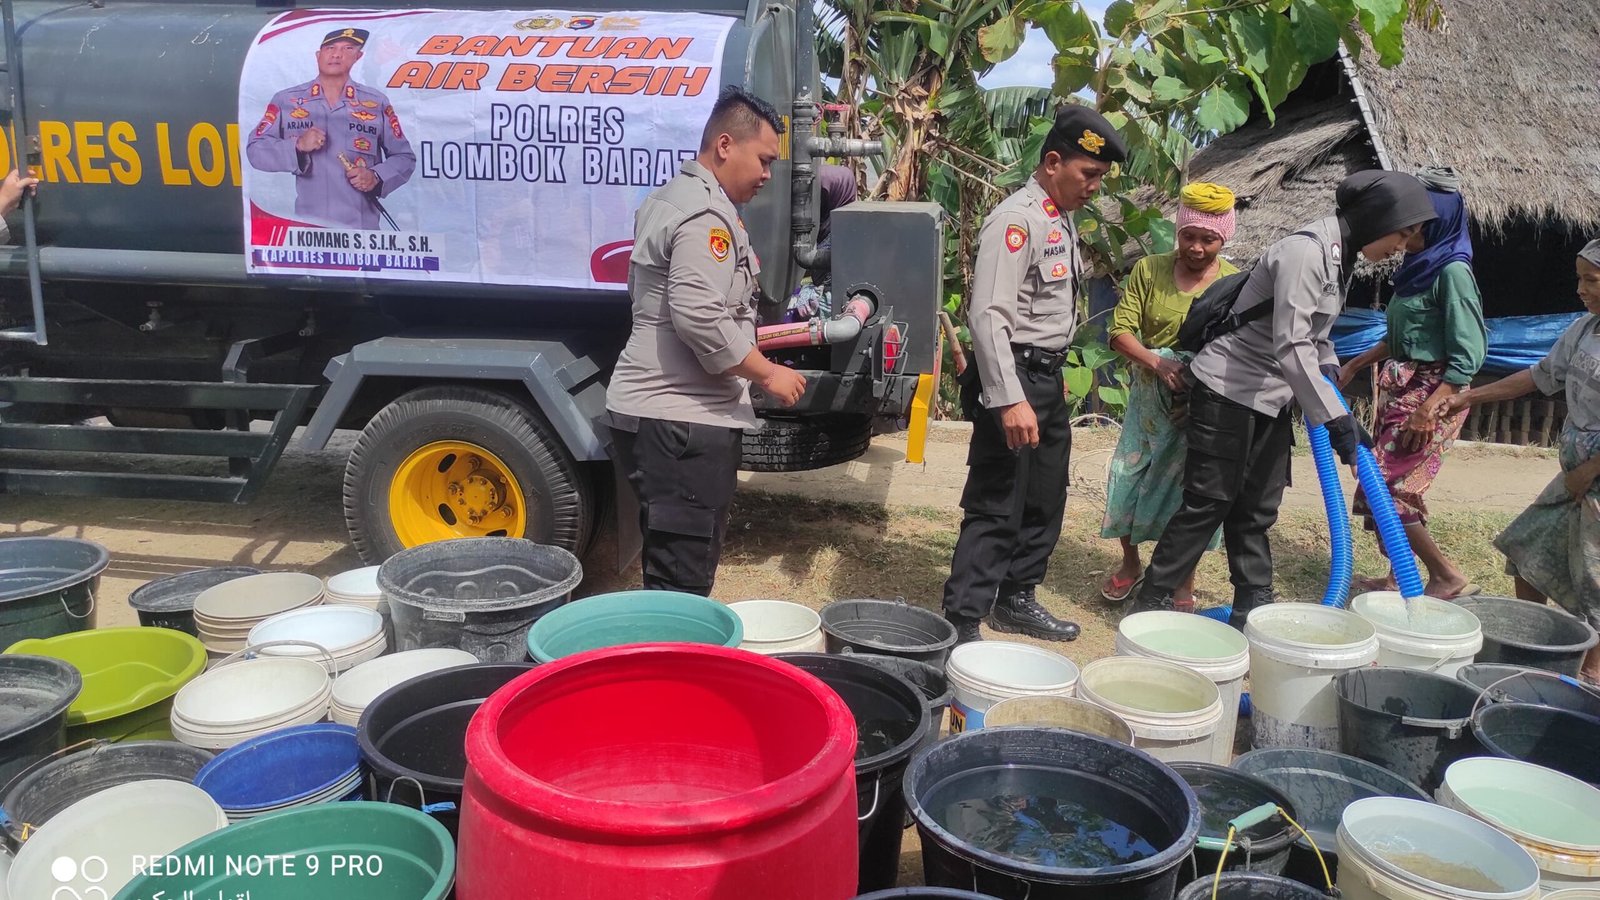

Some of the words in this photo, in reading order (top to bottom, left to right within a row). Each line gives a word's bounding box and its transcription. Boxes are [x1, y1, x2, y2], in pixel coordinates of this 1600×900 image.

[417, 35, 694, 60] BANTUAN
[386, 61, 489, 91] AIR
[496, 63, 712, 97] BERSIH
[349, 122, 378, 136] POLRI
[491, 103, 625, 145] POLRES
[421, 141, 566, 184] LOMBOK
[289, 230, 293, 246] I
[297, 230, 349, 249] KOMANG
[353, 233, 365, 250] S.
[408, 236, 432, 252] S.H.
[1044, 245, 1065, 257] HASAN
[261, 249, 324, 264] KAPOLRES
[330, 253, 379, 267] LOMBOK
[386, 255, 424, 269] BARAT
